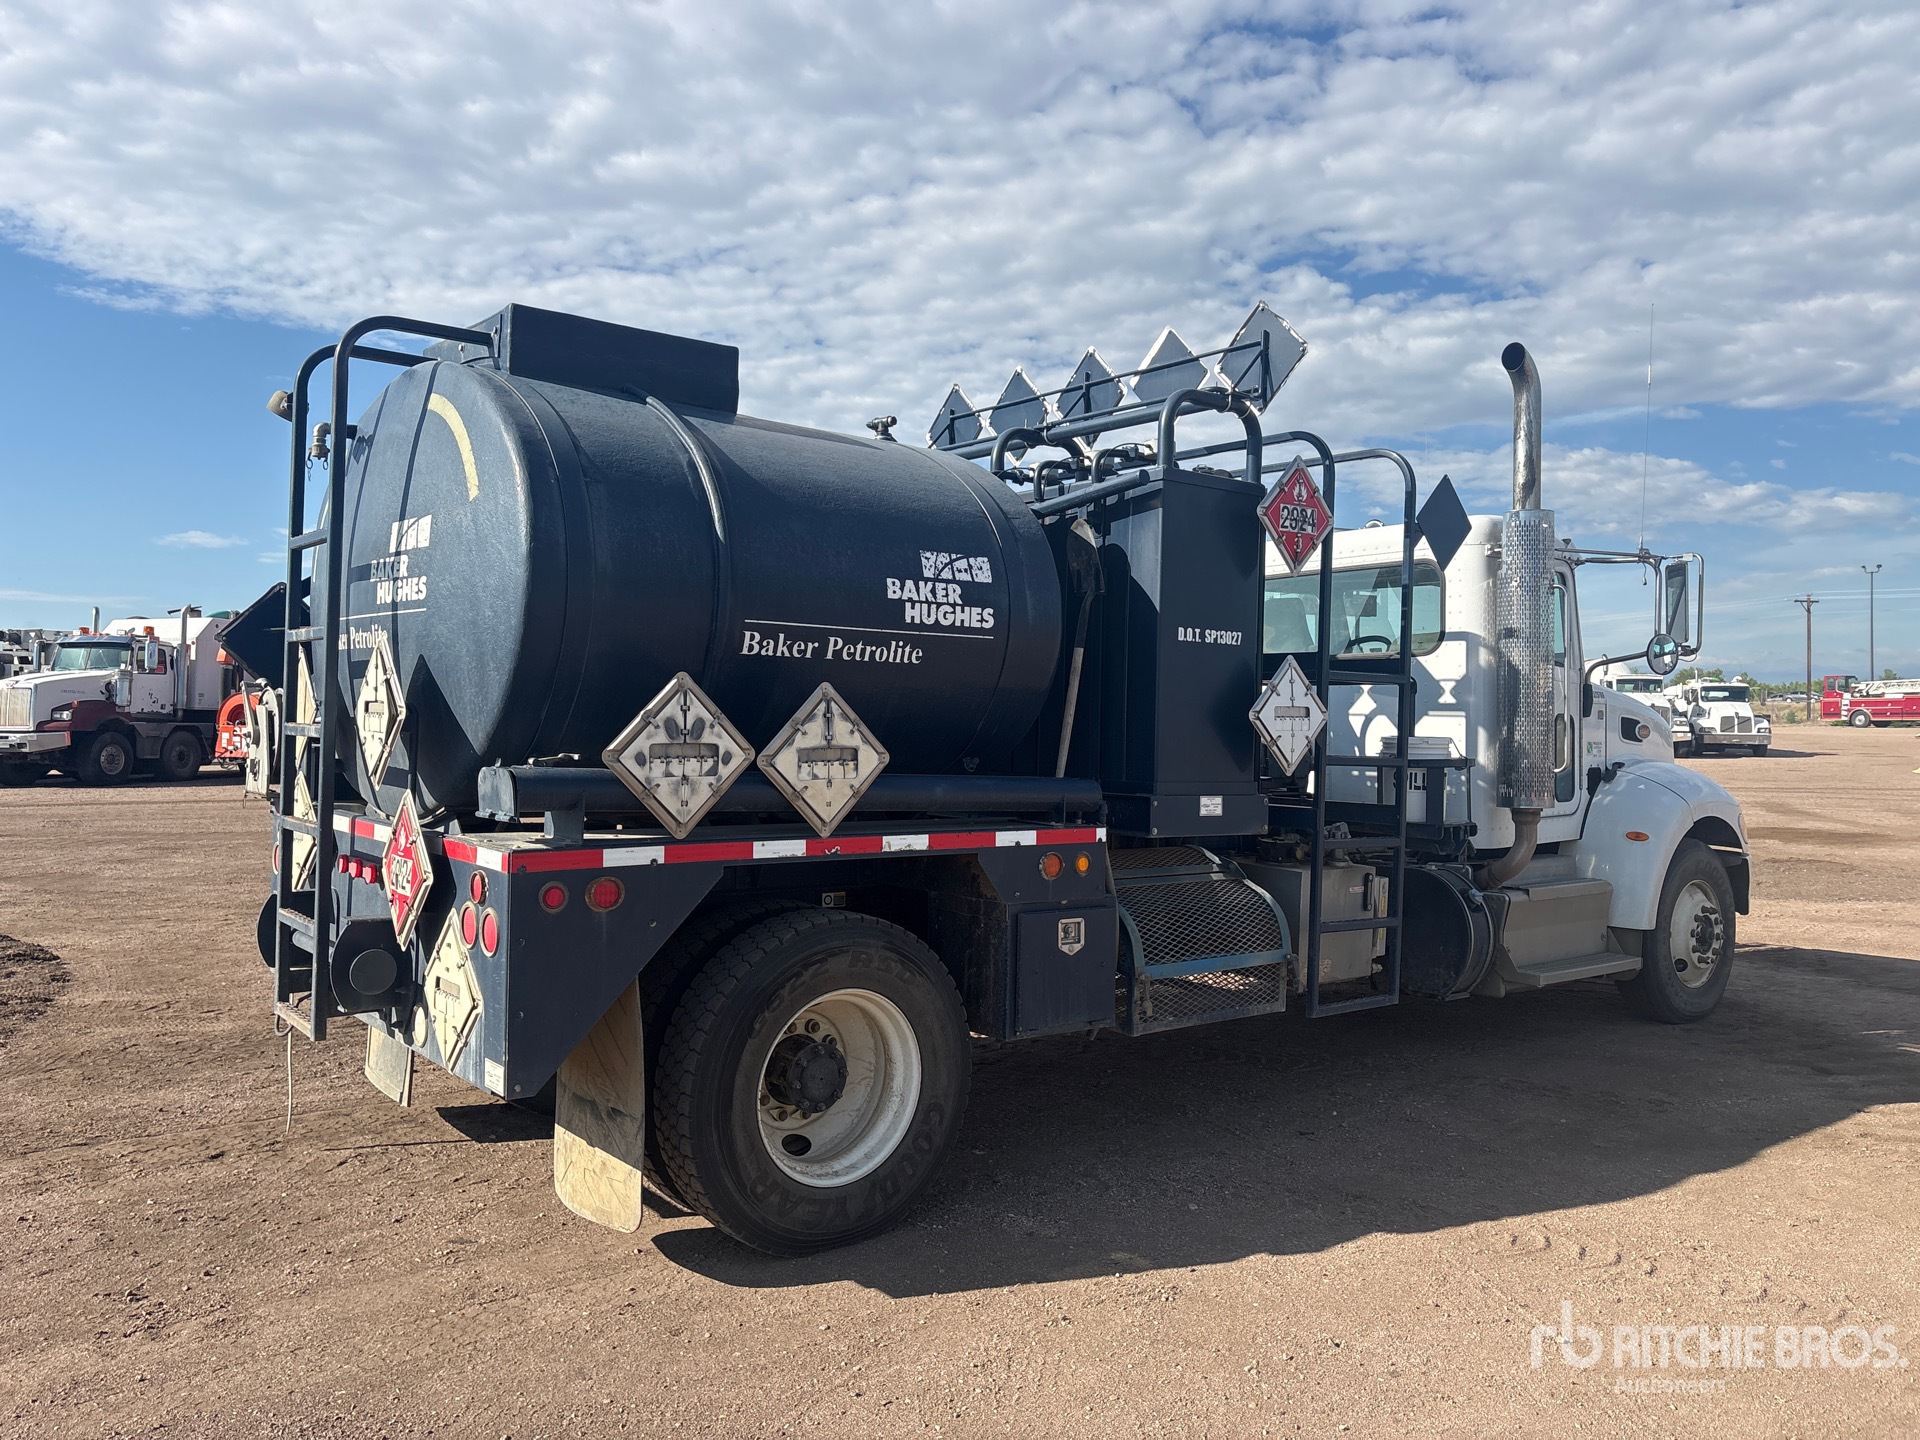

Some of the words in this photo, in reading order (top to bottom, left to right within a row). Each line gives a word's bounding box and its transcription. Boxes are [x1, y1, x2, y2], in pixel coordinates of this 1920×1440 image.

[1281, 505, 1316, 533] 2924
[370, 554, 408, 582] BAKER
[376, 576, 427, 605] HUGHES
[886, 577, 963, 605] BAKER
[904, 602, 995, 629] HUGHES
[739, 630, 819, 659] Baker
[824, 636, 923, 664] Petrolite
[1177, 626, 1202, 643] D.O.T.
[1204, 629, 1242, 646] SP13027
